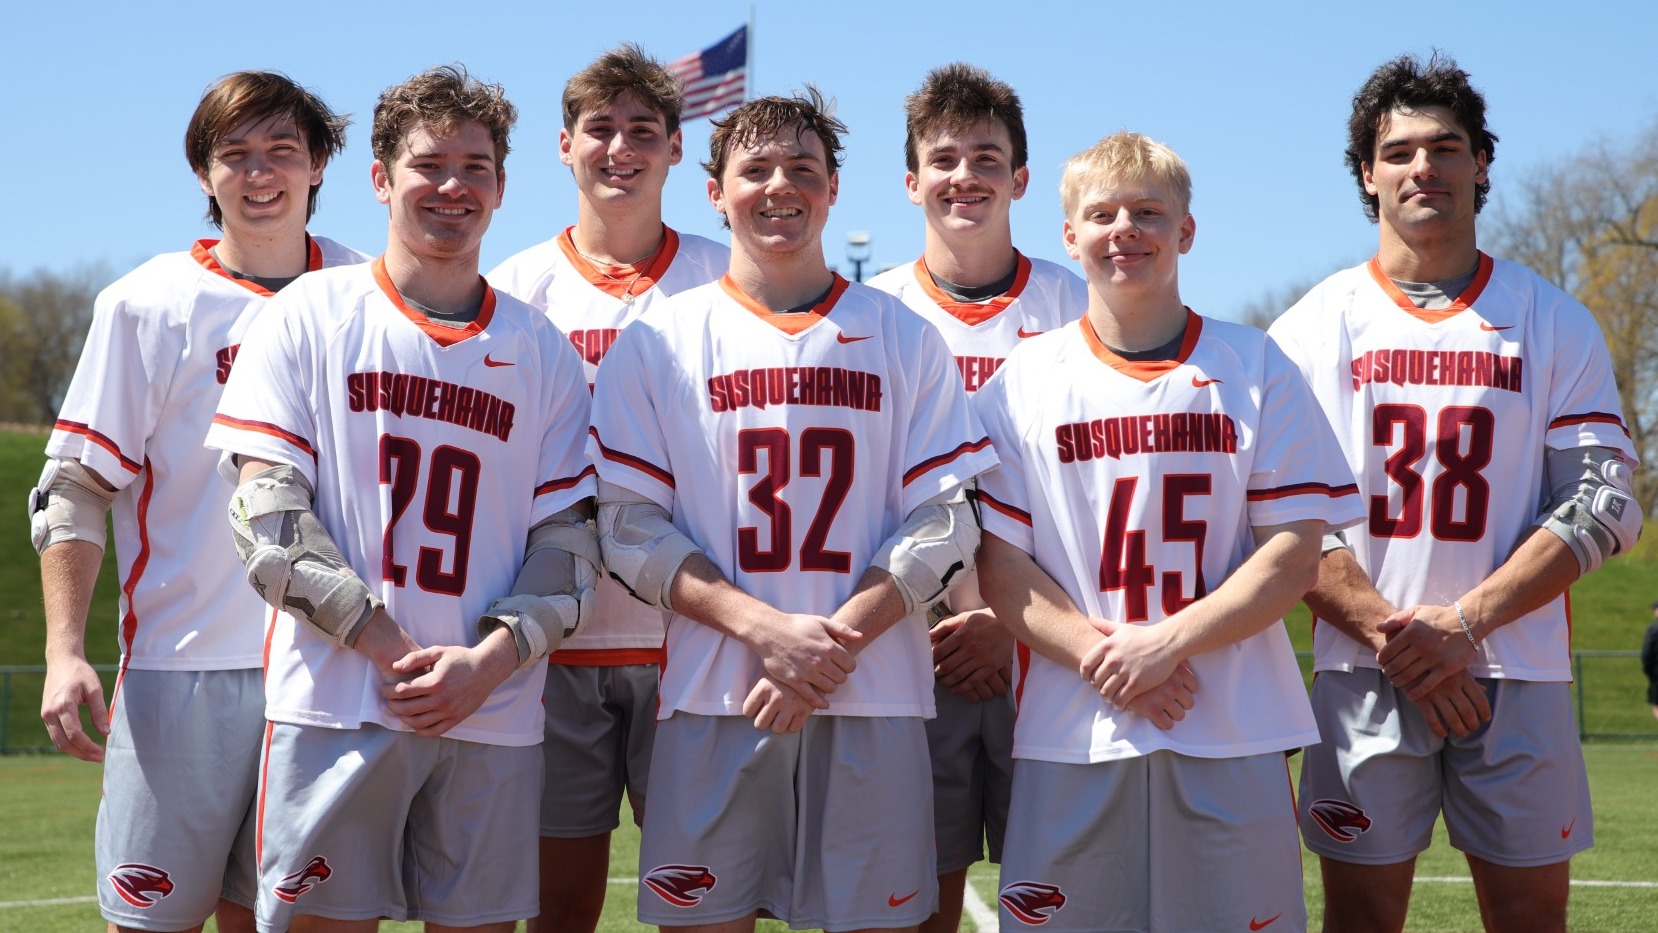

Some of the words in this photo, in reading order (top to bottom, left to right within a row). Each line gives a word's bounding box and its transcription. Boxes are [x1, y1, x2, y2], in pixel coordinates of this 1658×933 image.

[347, 371, 515, 442] SUSQUEHANNA
[707, 367, 882, 412] SUSQUEHANNA
[1351, 349, 1522, 393] SUSQUEHANNA
[1055, 413, 1238, 463] SUSQUEHANNA
[1369, 404, 1495, 542] 38
[379, 433, 481, 597] 29
[738, 427, 854, 573] 32
[1099, 474, 1211, 623] 45
